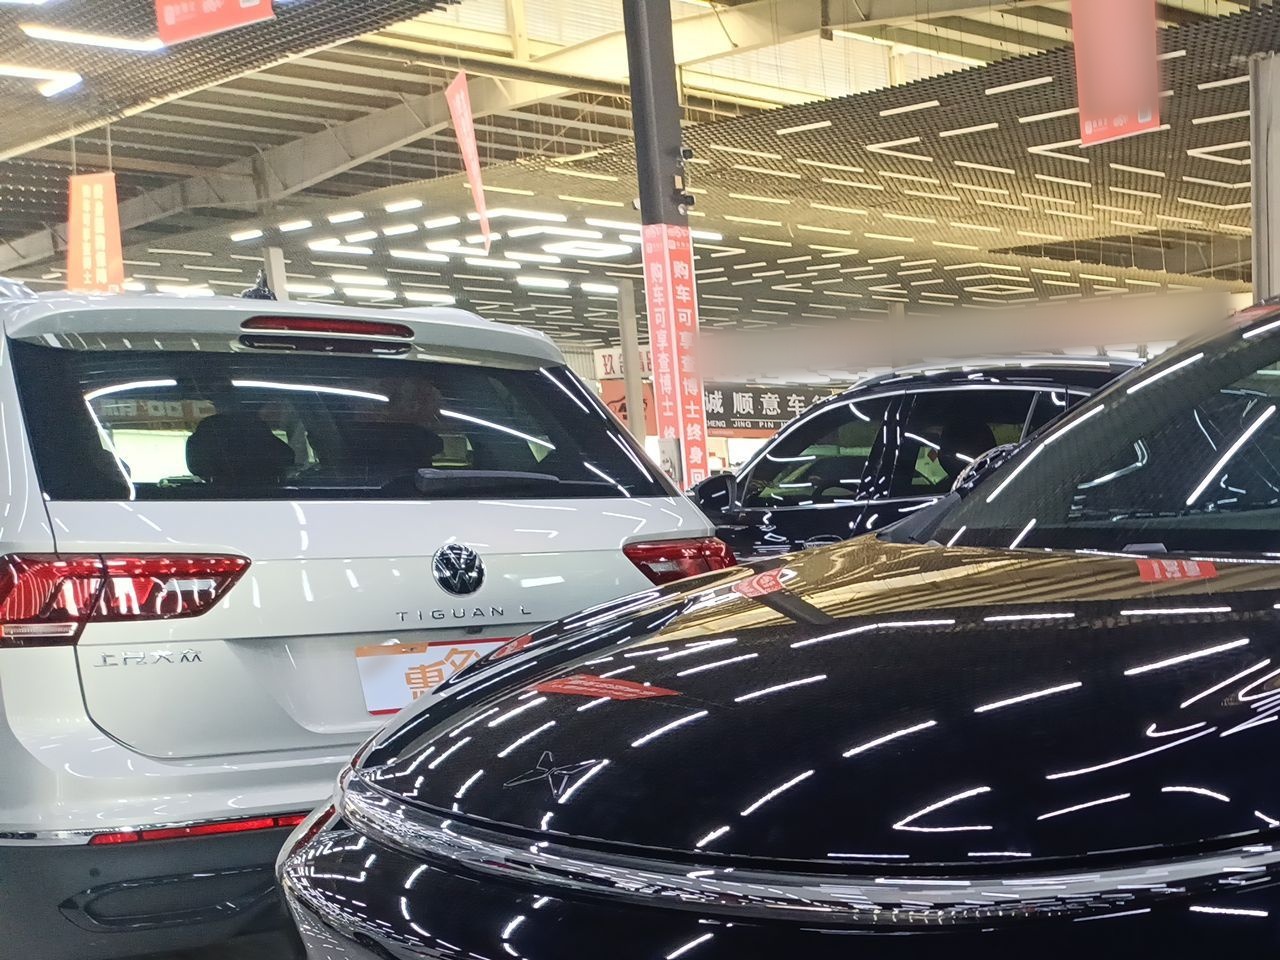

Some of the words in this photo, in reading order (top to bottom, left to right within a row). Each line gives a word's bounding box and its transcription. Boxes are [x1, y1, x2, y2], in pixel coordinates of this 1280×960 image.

[706, 420, 726, 428] HENG
[396, 606, 504, 621] TIGUAN
[520, 604, 532, 615] L
